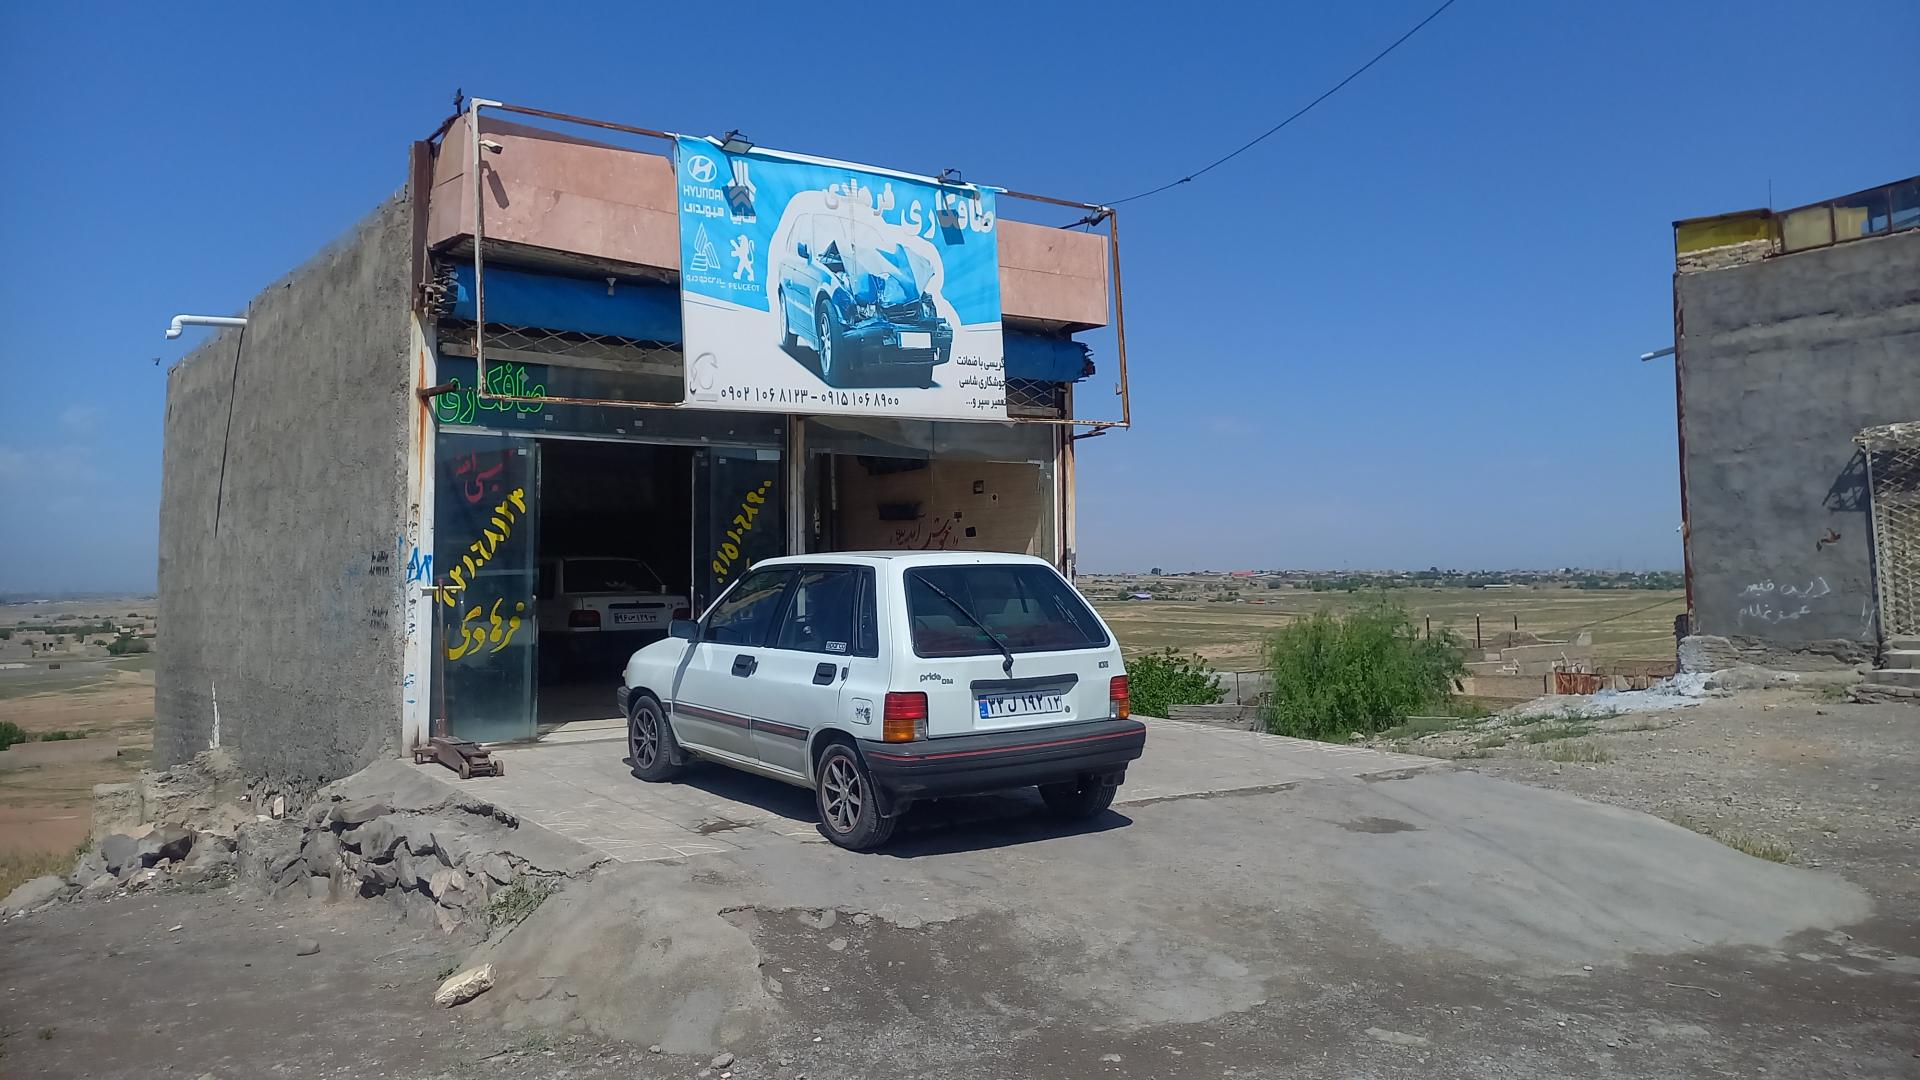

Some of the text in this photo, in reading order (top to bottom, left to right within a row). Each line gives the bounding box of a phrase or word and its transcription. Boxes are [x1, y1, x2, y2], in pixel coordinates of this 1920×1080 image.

[683, 185, 724, 201] HYUNDAI
[825, 178, 994, 239] صافکاری فرهادی
[956, 355, 978, 366] ضمانت
[436, 363, 546, 423] صافکاری
[959, 375, 978, 388] شاسی
[448, 598, 525, 660] فرهادی
